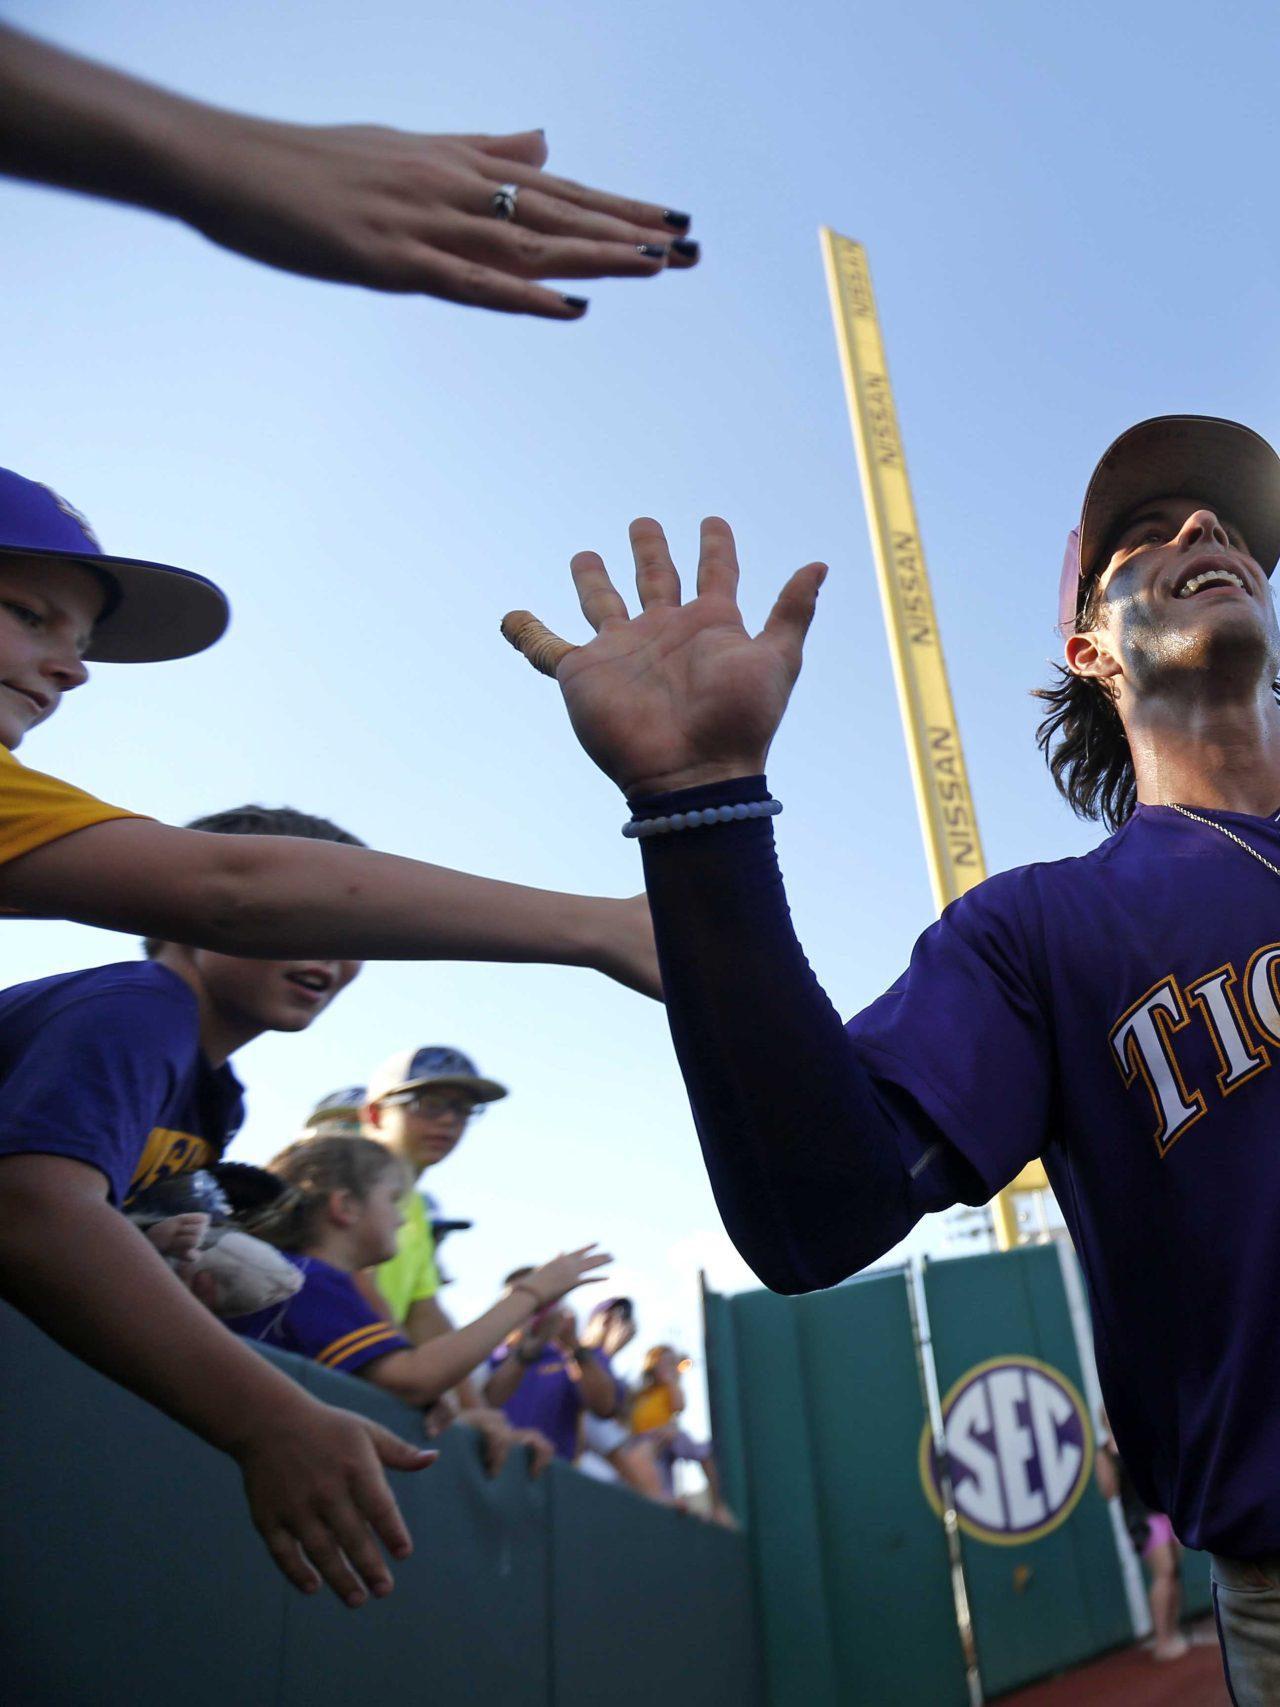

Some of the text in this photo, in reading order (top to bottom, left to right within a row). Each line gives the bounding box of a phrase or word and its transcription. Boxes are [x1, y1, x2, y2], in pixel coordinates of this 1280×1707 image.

[866, 371, 898, 464] NISSAN
[891, 530, 934, 646] NISSAN
[927, 725, 977, 867] NISSAN
[944, 1366, 1083, 1532] SEC
